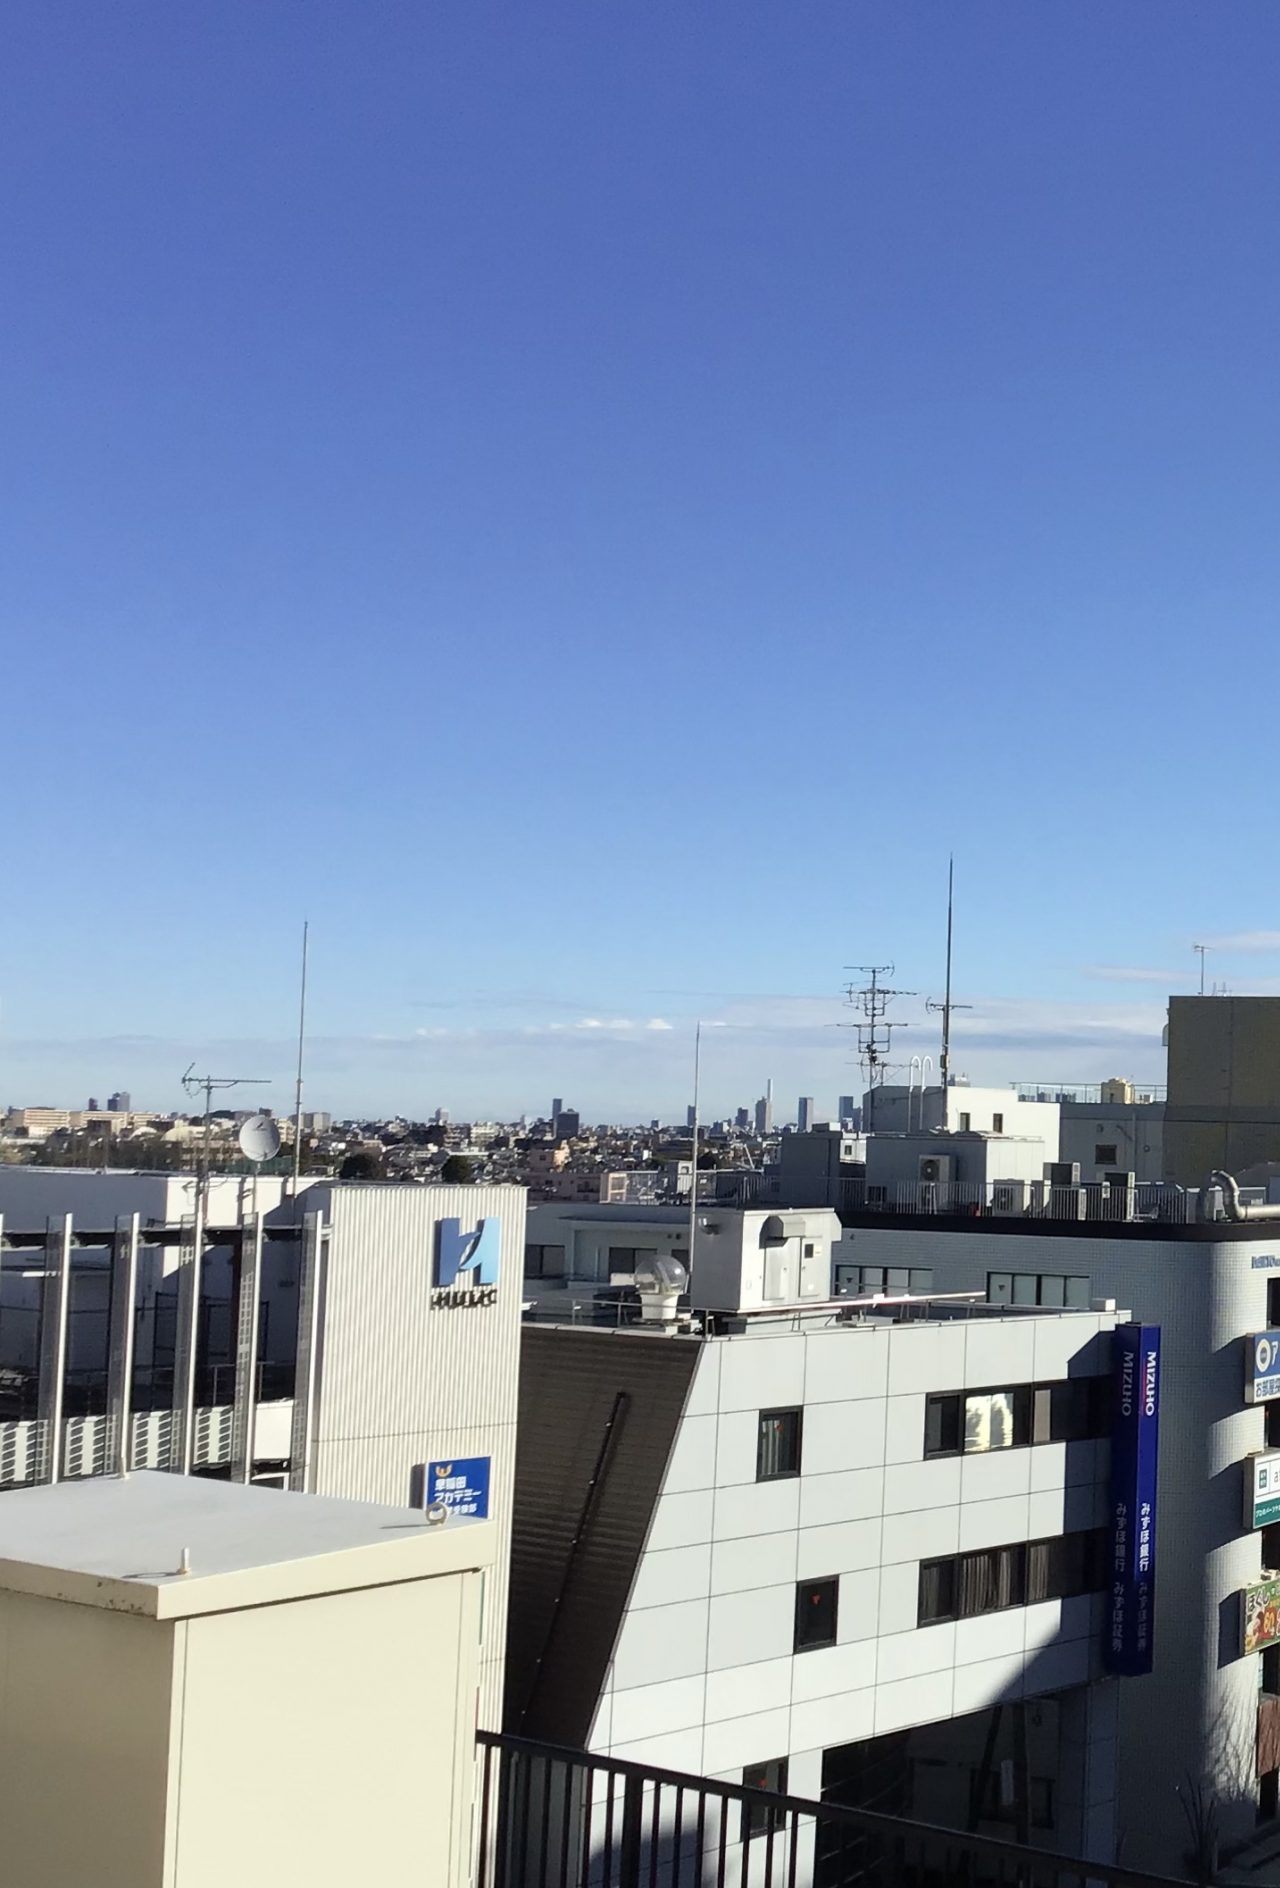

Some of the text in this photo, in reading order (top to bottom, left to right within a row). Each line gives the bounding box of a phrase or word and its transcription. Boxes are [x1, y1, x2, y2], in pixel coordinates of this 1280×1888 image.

[1121, 1352, 1134, 1417] MIZUHO
[1145, 1352, 1157, 1417] MIZUHO
[1115, 1503, 1127, 1573] みずほ銀行
[1139, 1503, 1151, 1573] みずほ銀行
